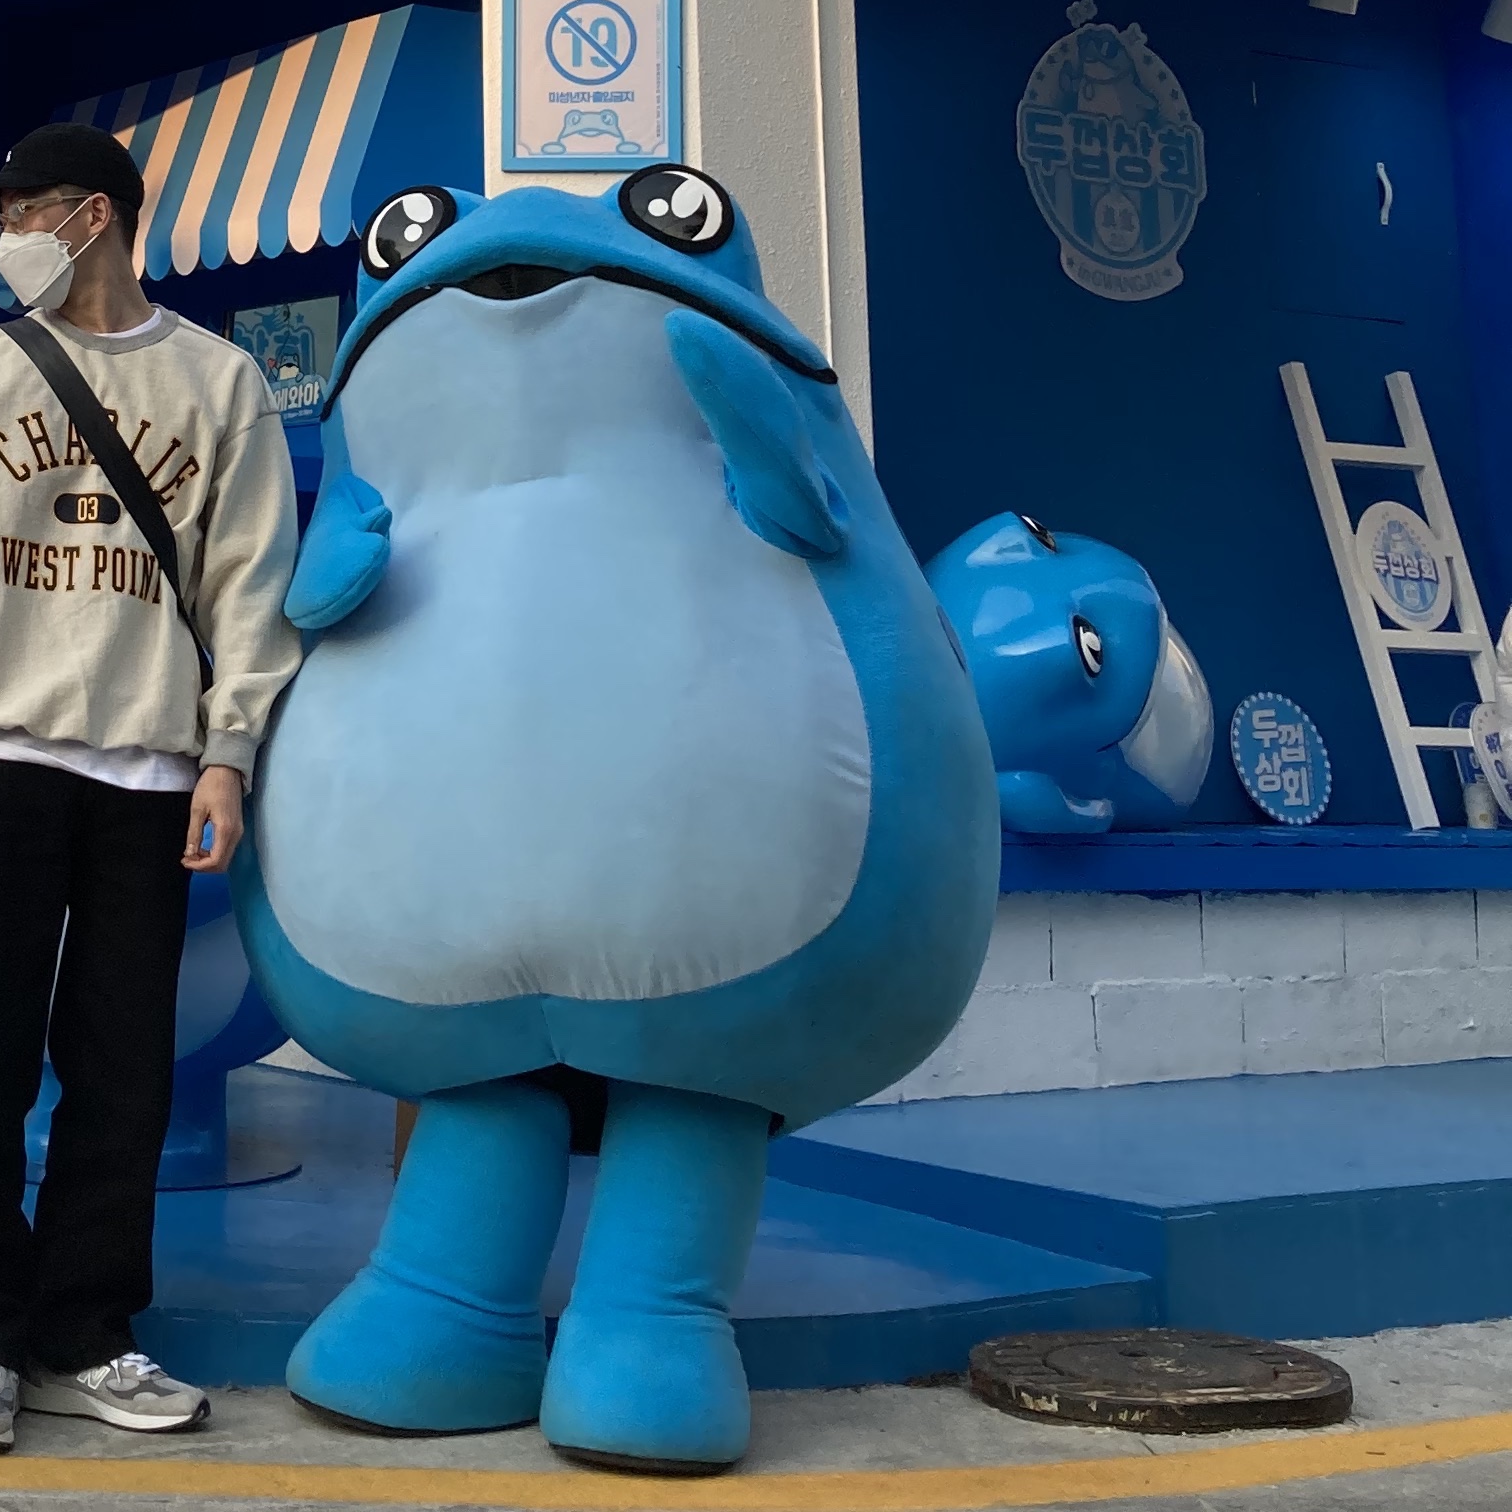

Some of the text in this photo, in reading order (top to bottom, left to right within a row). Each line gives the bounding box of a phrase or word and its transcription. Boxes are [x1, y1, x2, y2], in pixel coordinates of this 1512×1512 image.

[1023, 110, 1198, 194] 두껍상회
[77, 496, 99, 522] 03
[1, 536, 80, 591] WEST
[1373, 550, 1439, 584] 두껍상회
